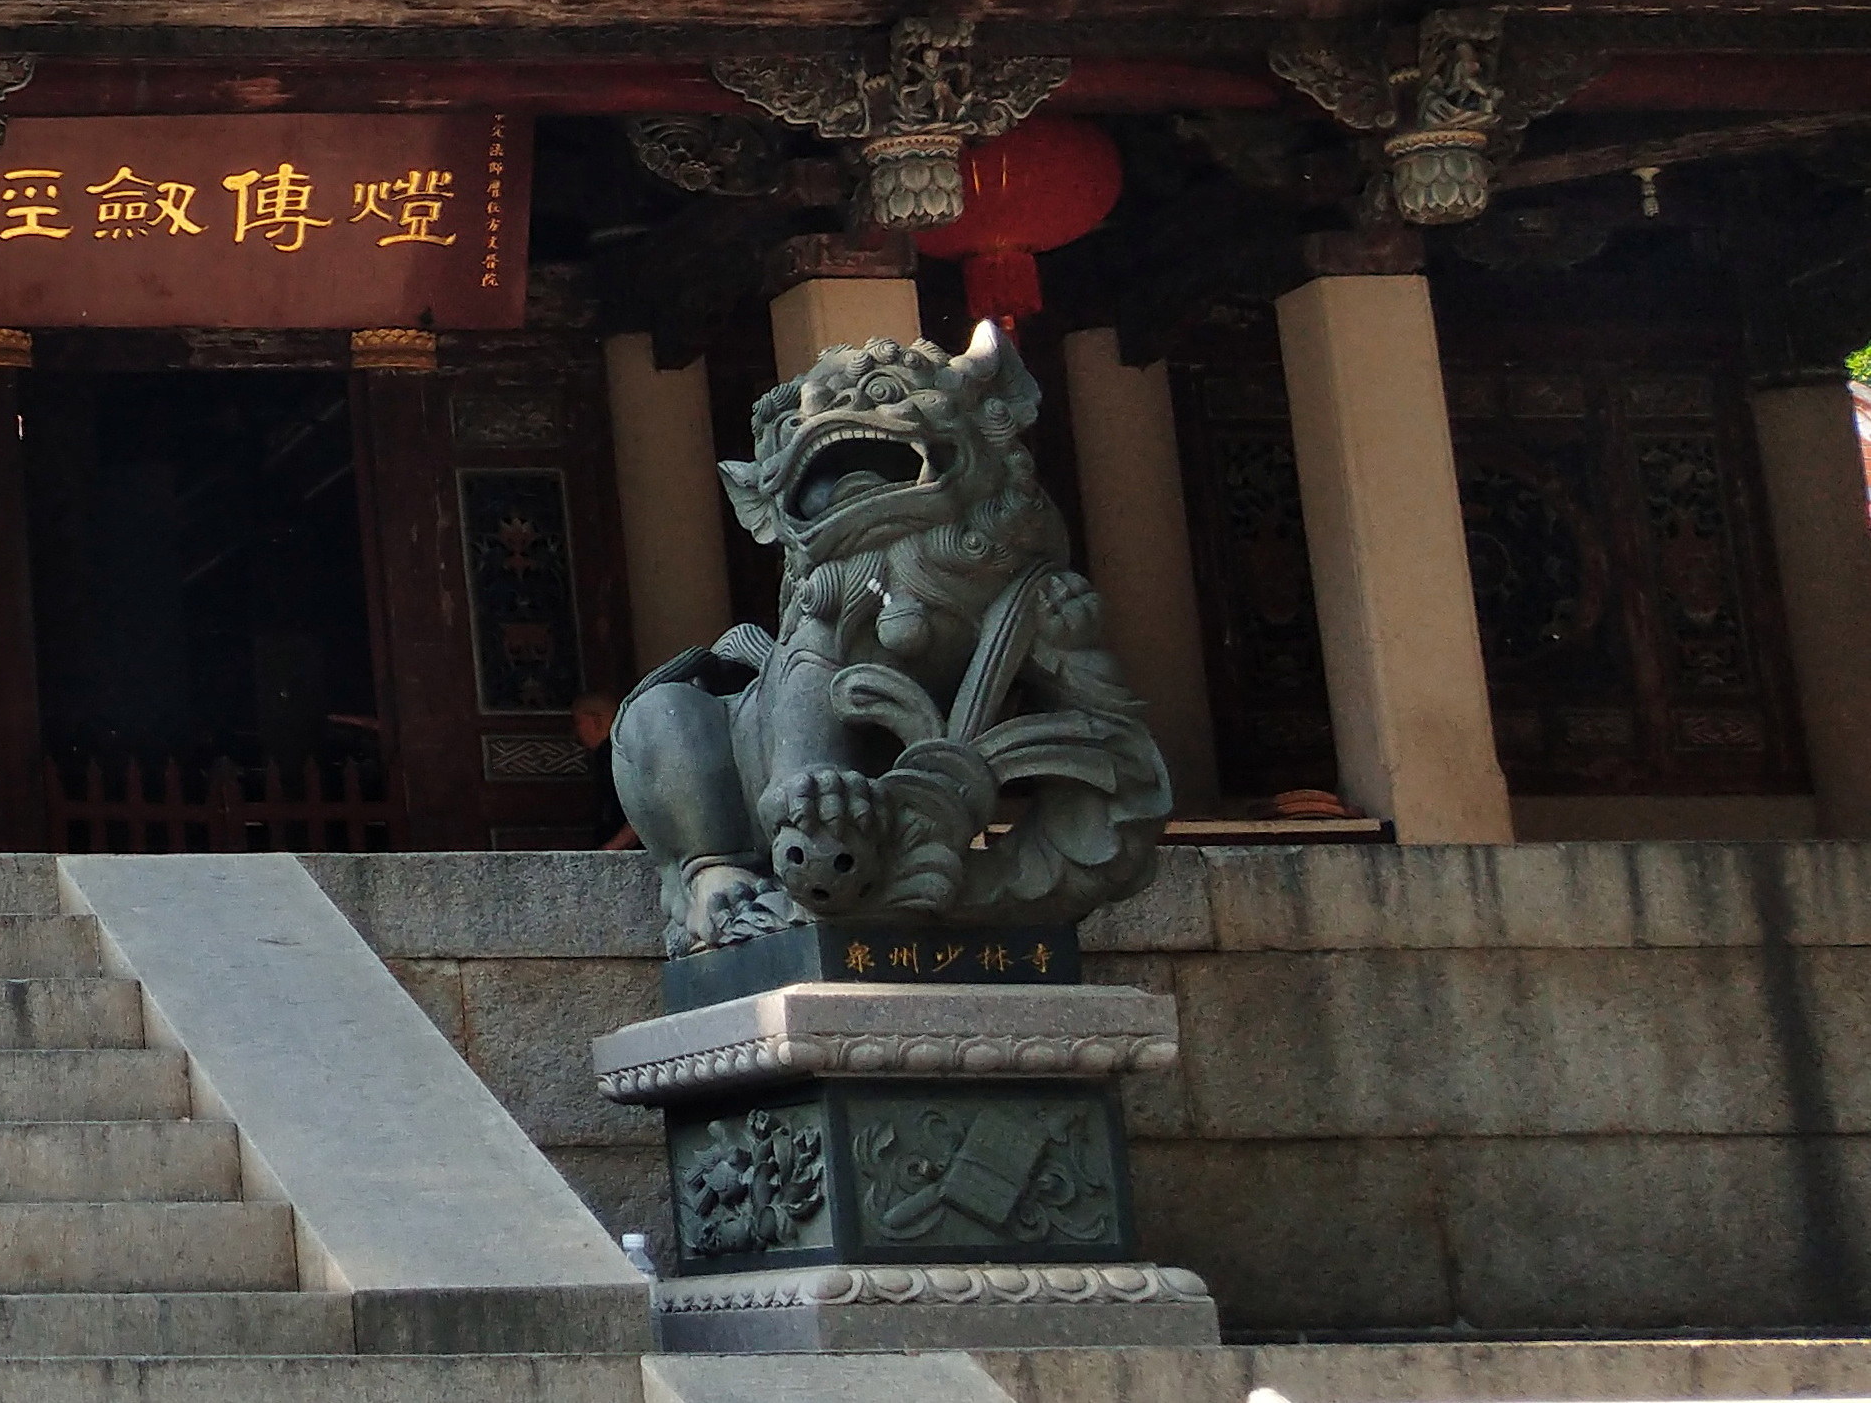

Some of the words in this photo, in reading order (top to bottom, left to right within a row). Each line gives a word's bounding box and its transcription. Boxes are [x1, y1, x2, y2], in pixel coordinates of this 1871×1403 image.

[844, 942, 1053, 975] 泉州少林寺
